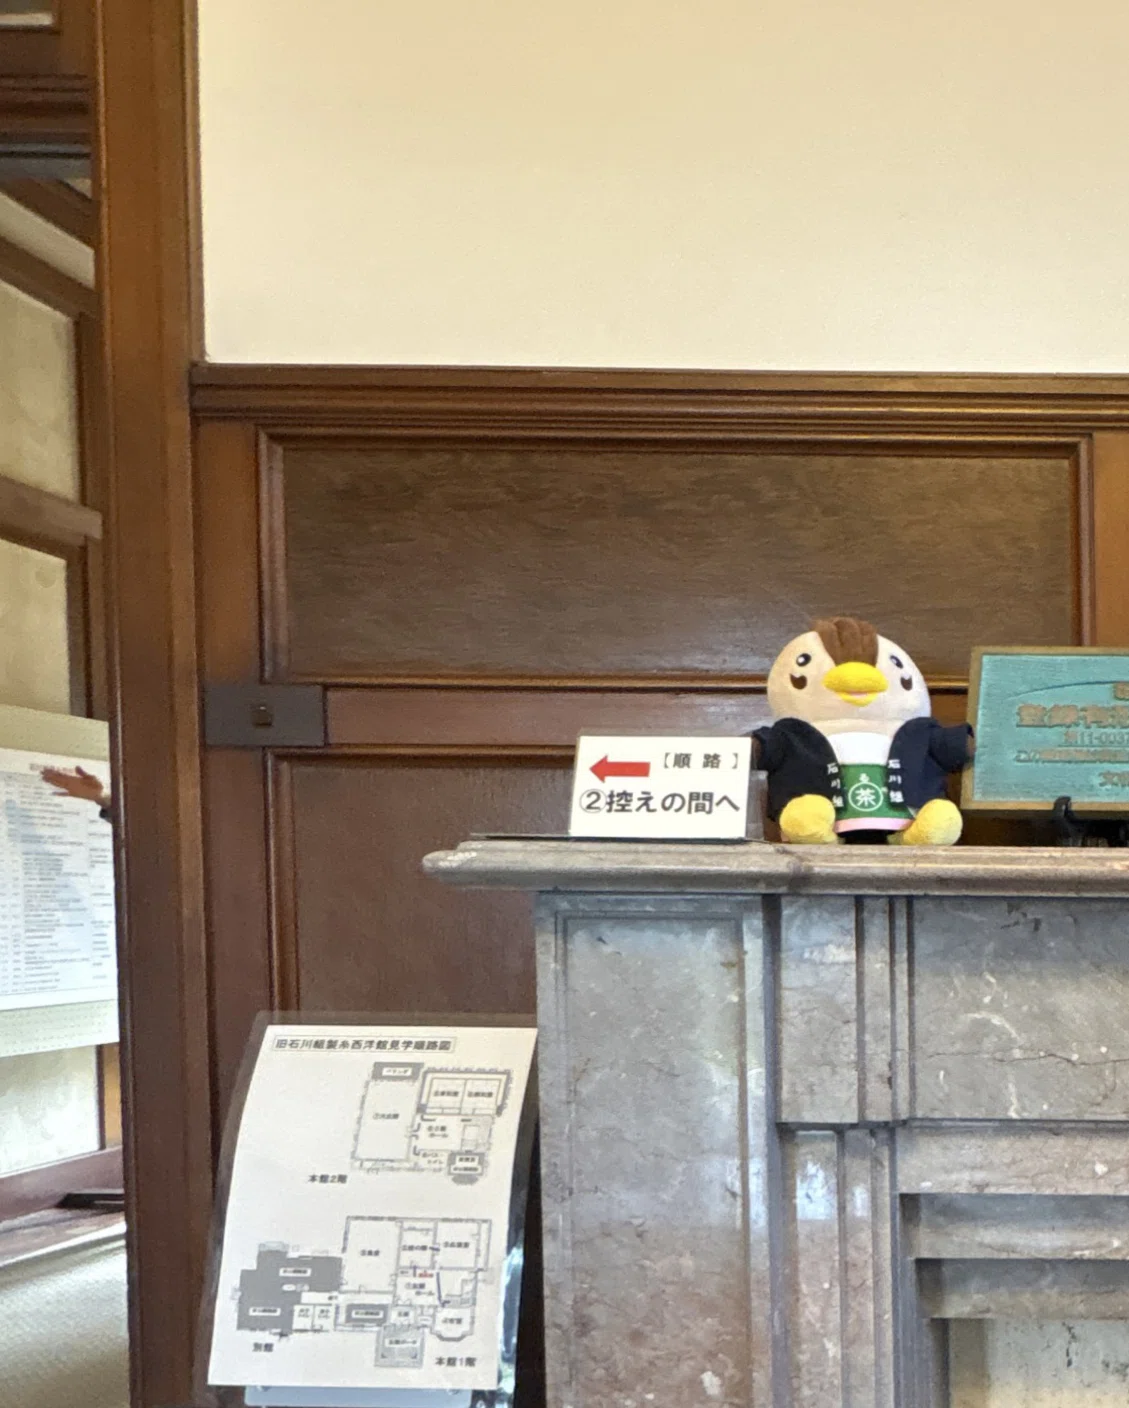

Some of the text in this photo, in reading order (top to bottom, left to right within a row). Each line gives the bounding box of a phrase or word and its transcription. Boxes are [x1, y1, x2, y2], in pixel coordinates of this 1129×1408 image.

[579, 788, 740, 815] ②控えの間へ
